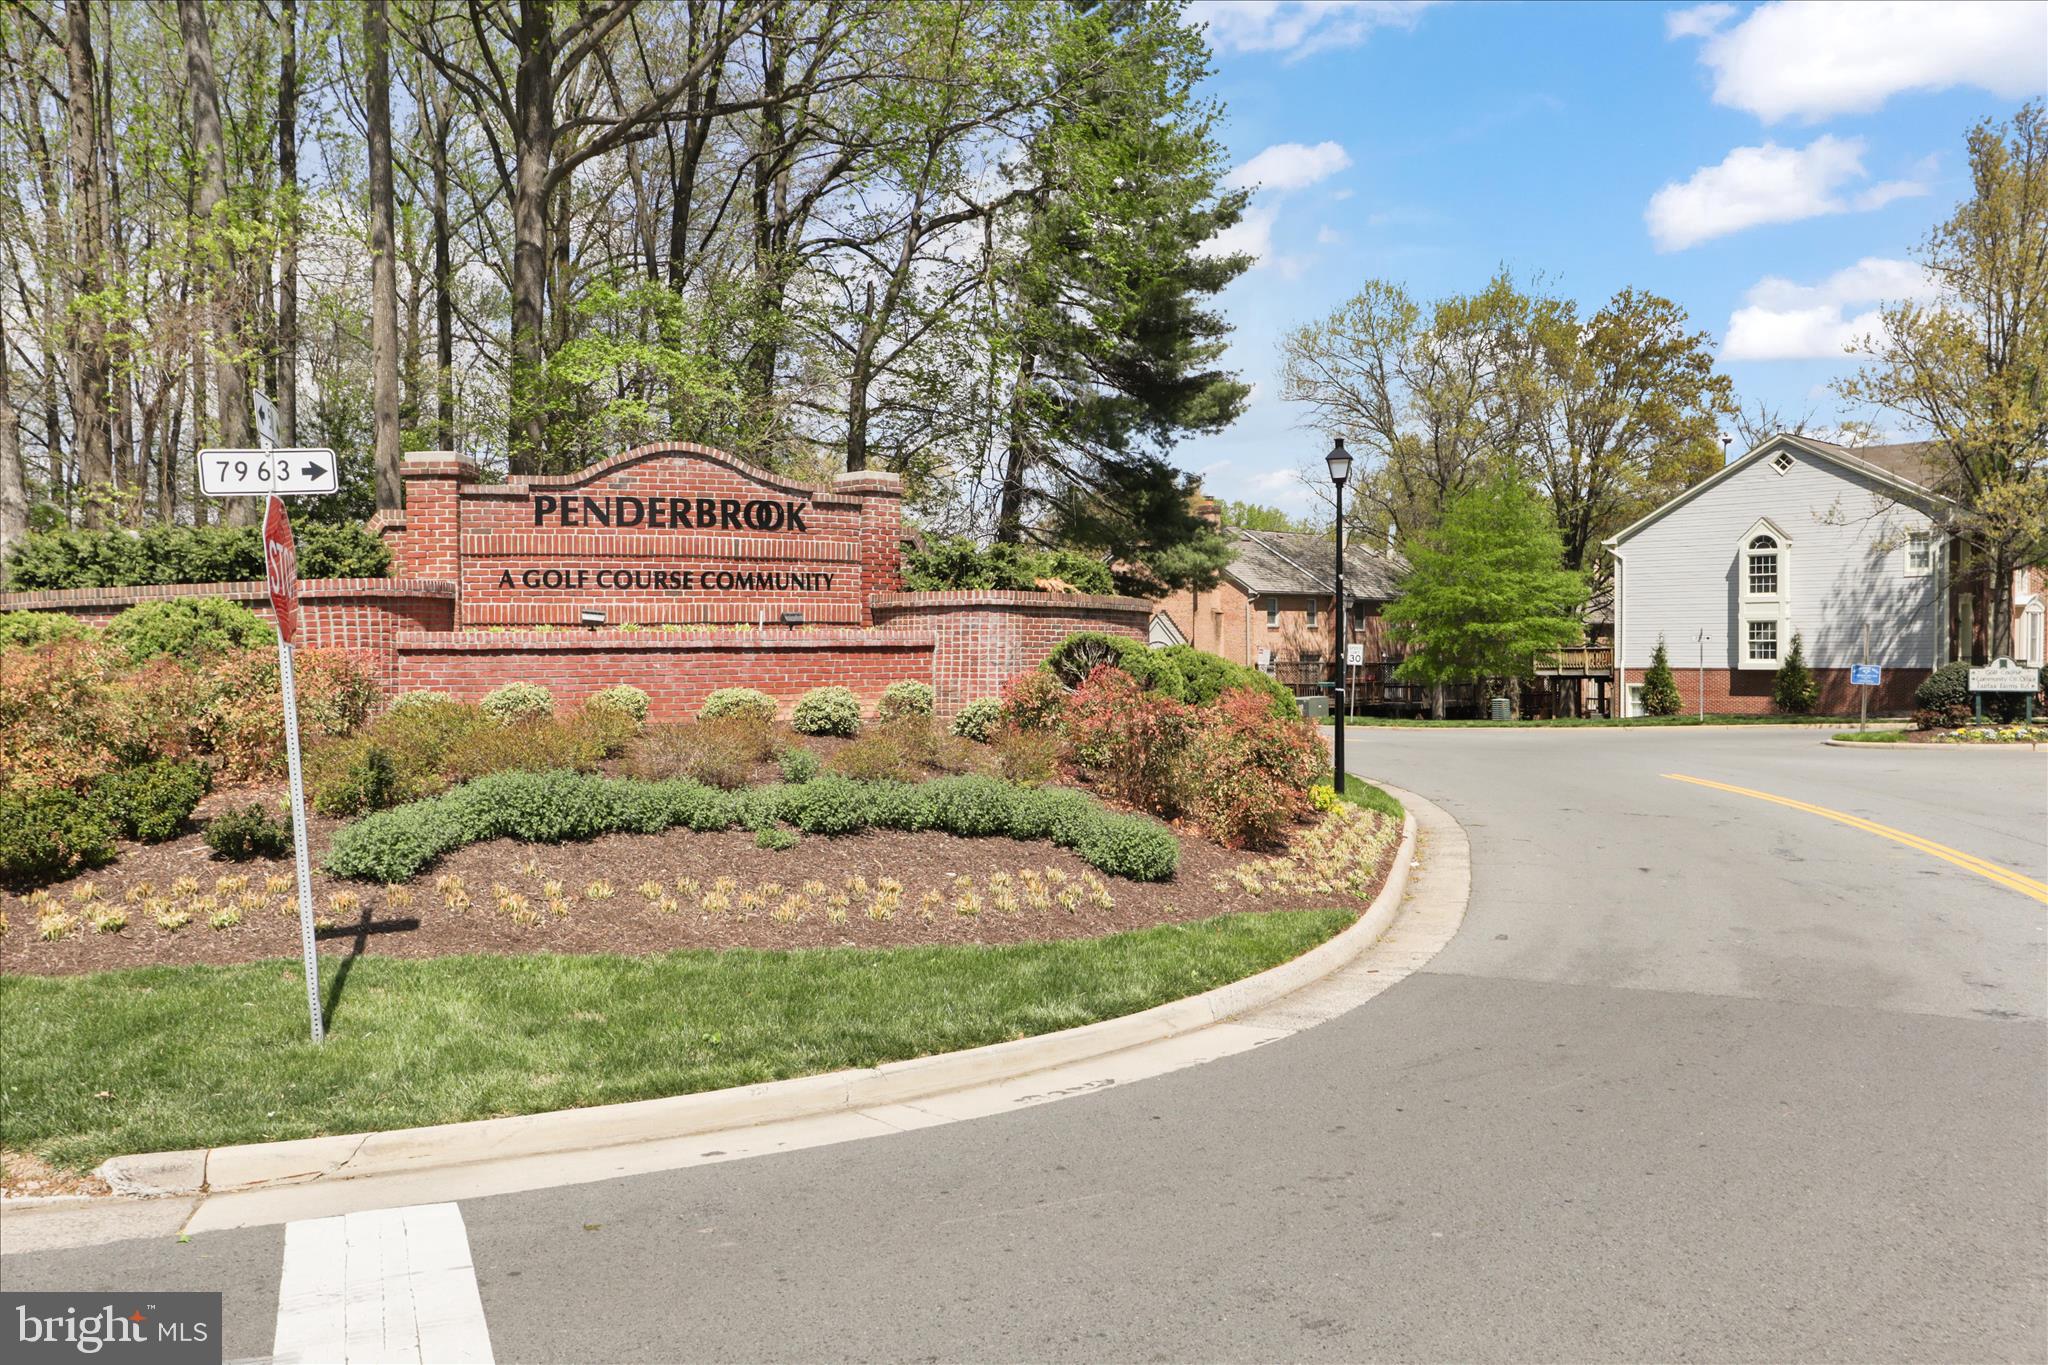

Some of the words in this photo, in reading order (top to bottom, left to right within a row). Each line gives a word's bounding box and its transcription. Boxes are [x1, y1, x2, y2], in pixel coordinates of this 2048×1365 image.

[216, 460, 290, 482] 7963
[534, 494, 808, 533] PENDERBROOK
[499, 569, 515, 589] A
[522, 569, 589, 589] GOLF
[596, 570, 694, 590] COURSE
[700, 571, 835, 592] COMMUNITY
[1349, 654, 1362, 663] 30
